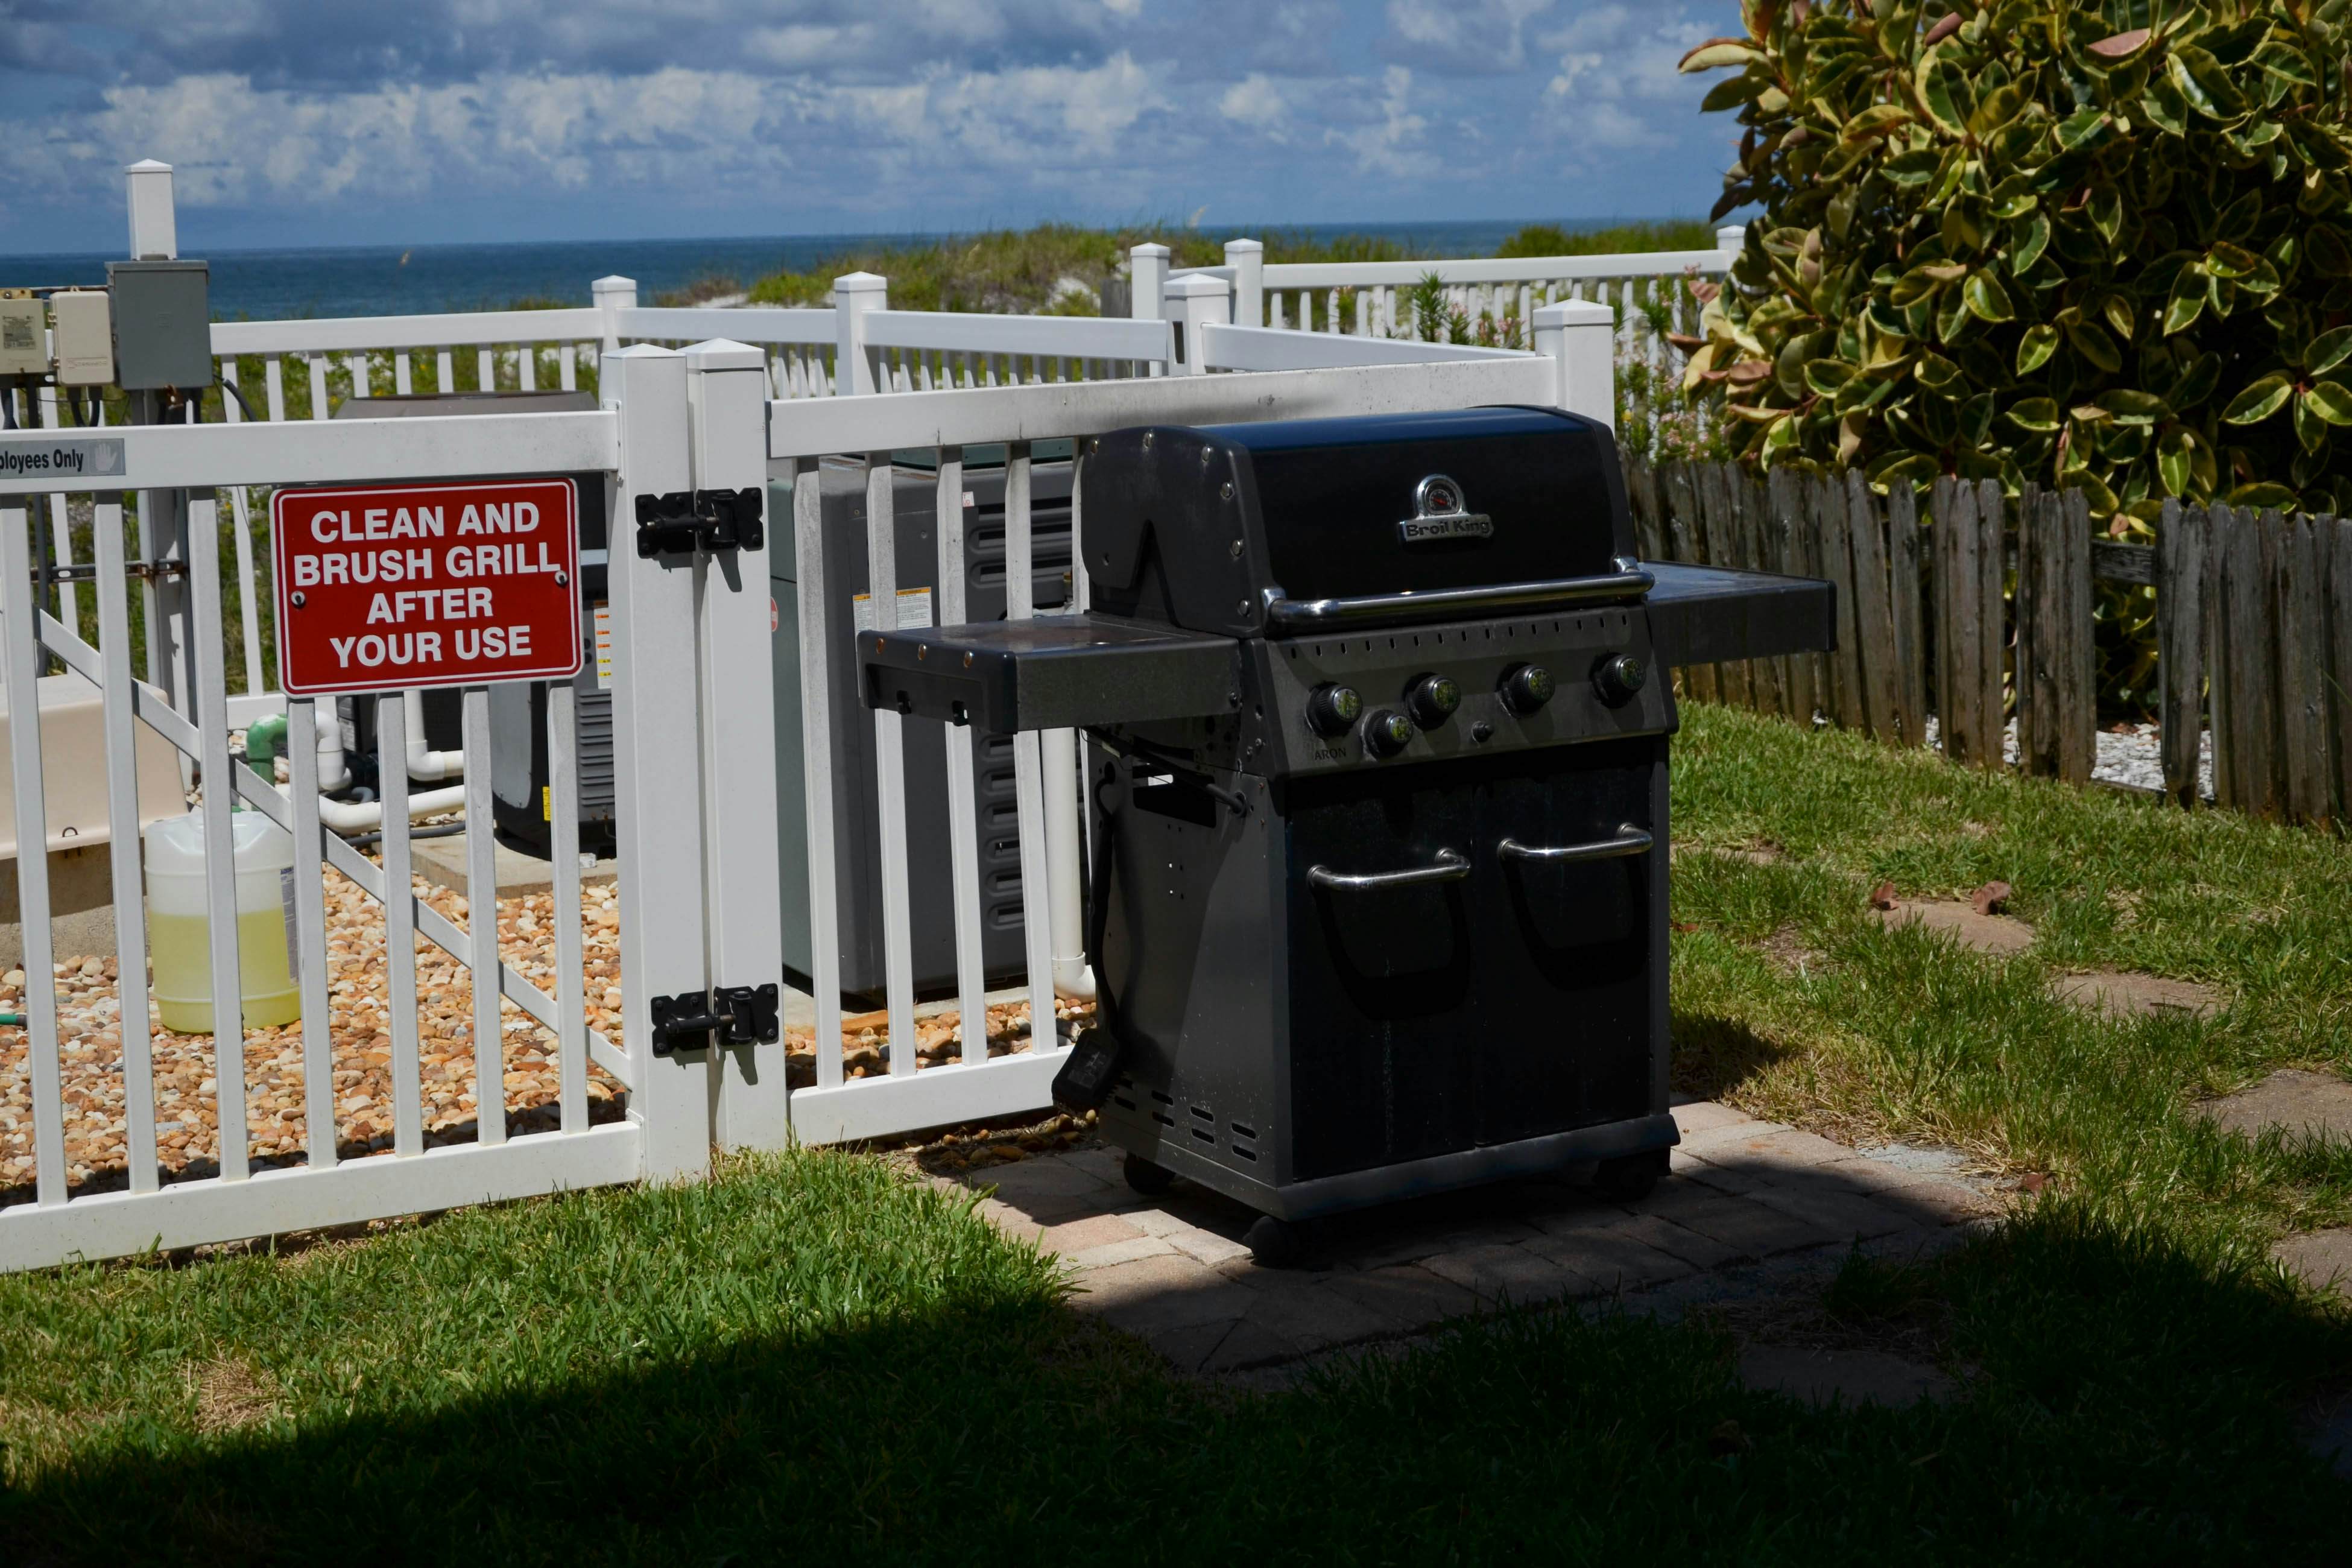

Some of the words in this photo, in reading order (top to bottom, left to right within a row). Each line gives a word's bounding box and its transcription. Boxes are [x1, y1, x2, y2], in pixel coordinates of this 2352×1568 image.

[53, 449, 84, 472] Only
[311, 505, 444, 543] CLEAN
[457, 502, 539, 536] AND
[1406, 521, 1449, 537] Broil
[1453, 519, 1490, 533] King
[294, 548, 432, 586] BRUSH
[445, 542, 561, 578] GRILL
[366, 587, 493, 625] AFTER
[329, 631, 442, 668] YOUR
[455, 625, 532, 660] USE
